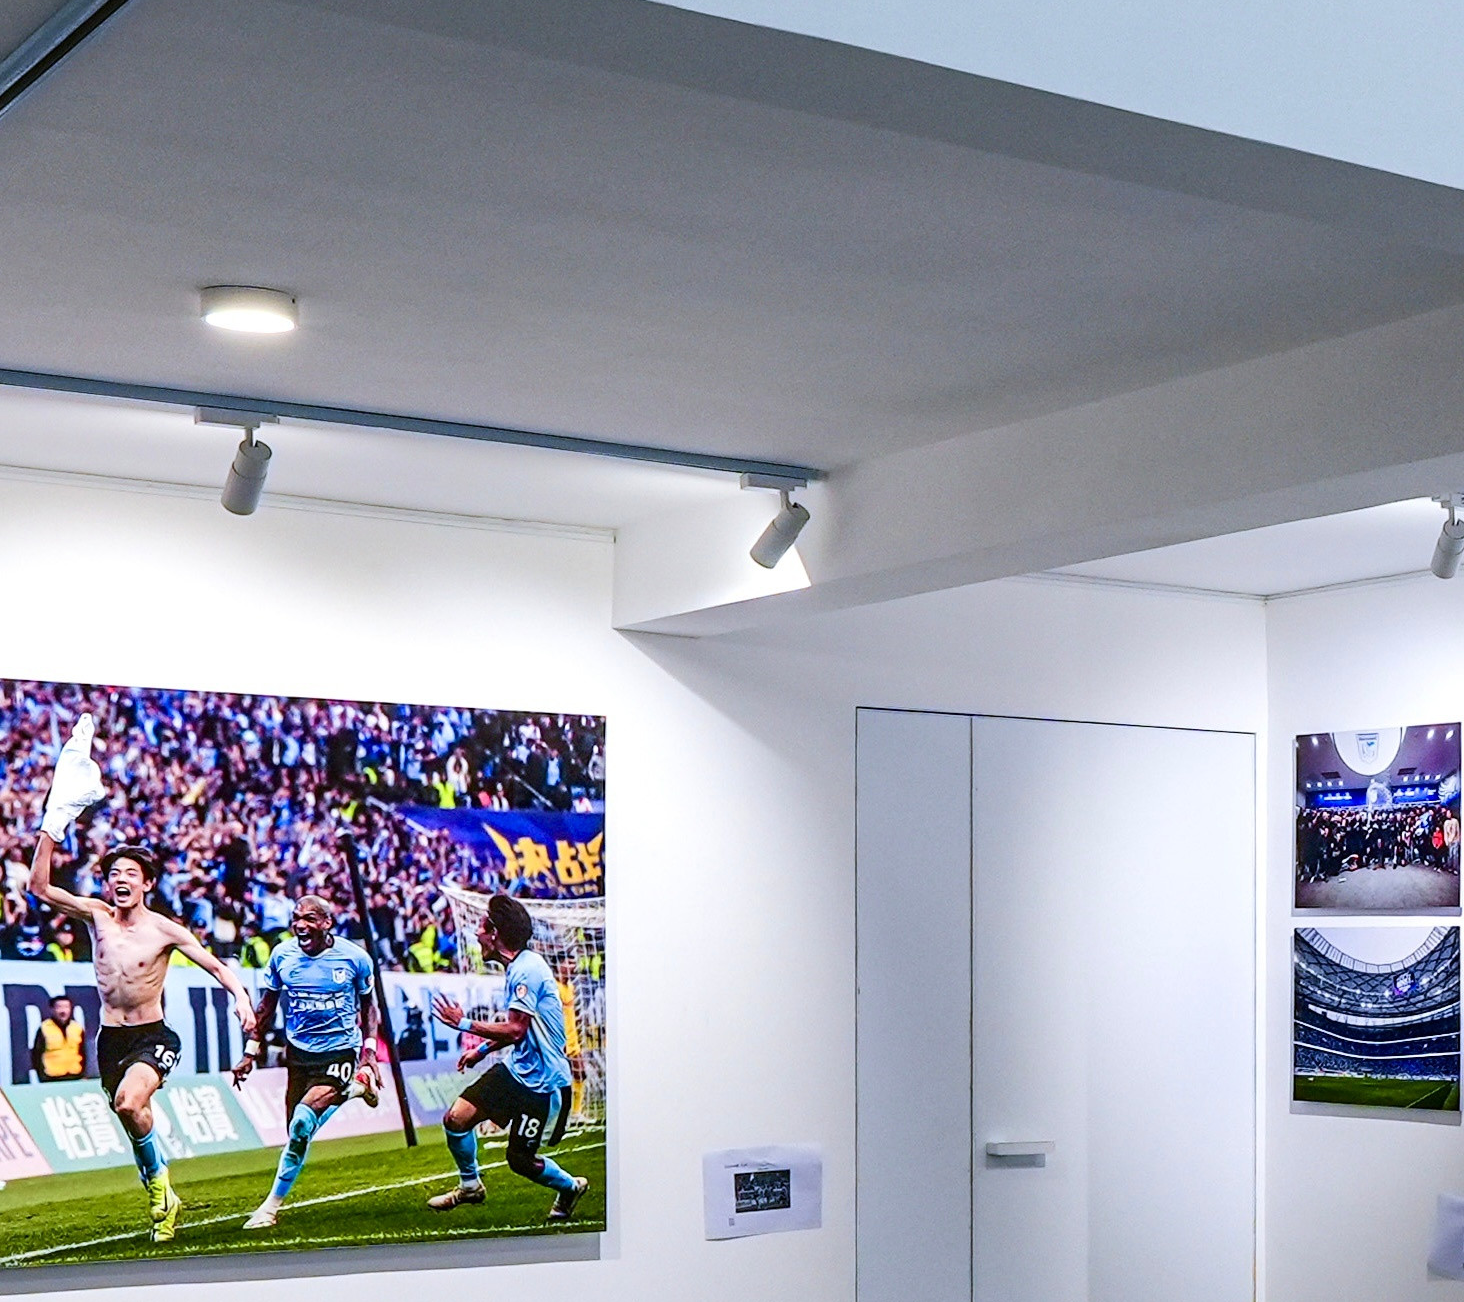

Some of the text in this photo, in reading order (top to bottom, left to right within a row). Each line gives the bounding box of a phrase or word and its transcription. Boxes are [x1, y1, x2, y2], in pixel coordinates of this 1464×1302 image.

[154, 1044, 176, 1068] 16
[325, 1061, 353, 1083] 40
[517, 1113, 541, 1138] 18
